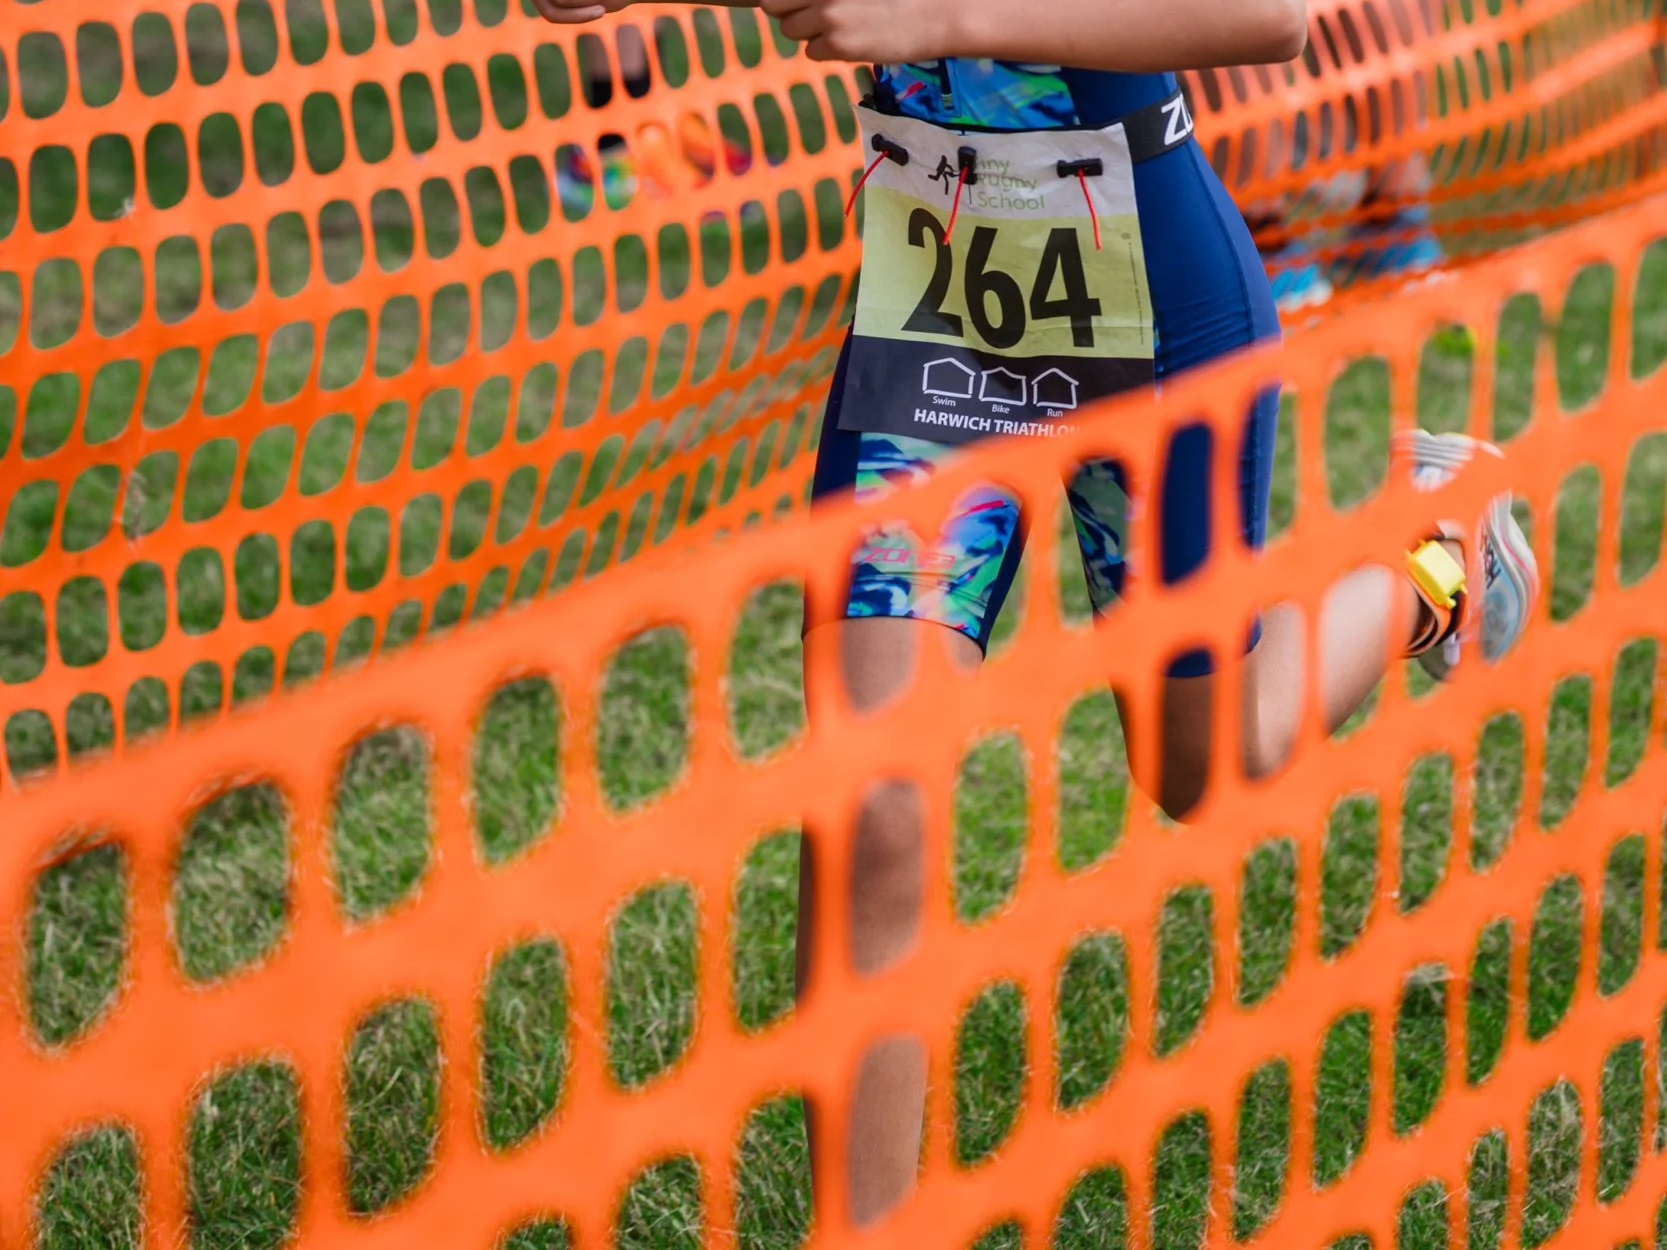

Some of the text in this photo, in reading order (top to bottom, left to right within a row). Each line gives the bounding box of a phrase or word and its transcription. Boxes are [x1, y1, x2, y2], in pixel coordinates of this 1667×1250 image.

[977, 191, 1045, 210] School
[901, 208, 1102, 349] 264
[932, 395, 956, 407] Swim
[991, 404, 1010, 414] Bike
[1047, 408, 1063, 418] Run
[914, 408, 991, 432] HARWICH
